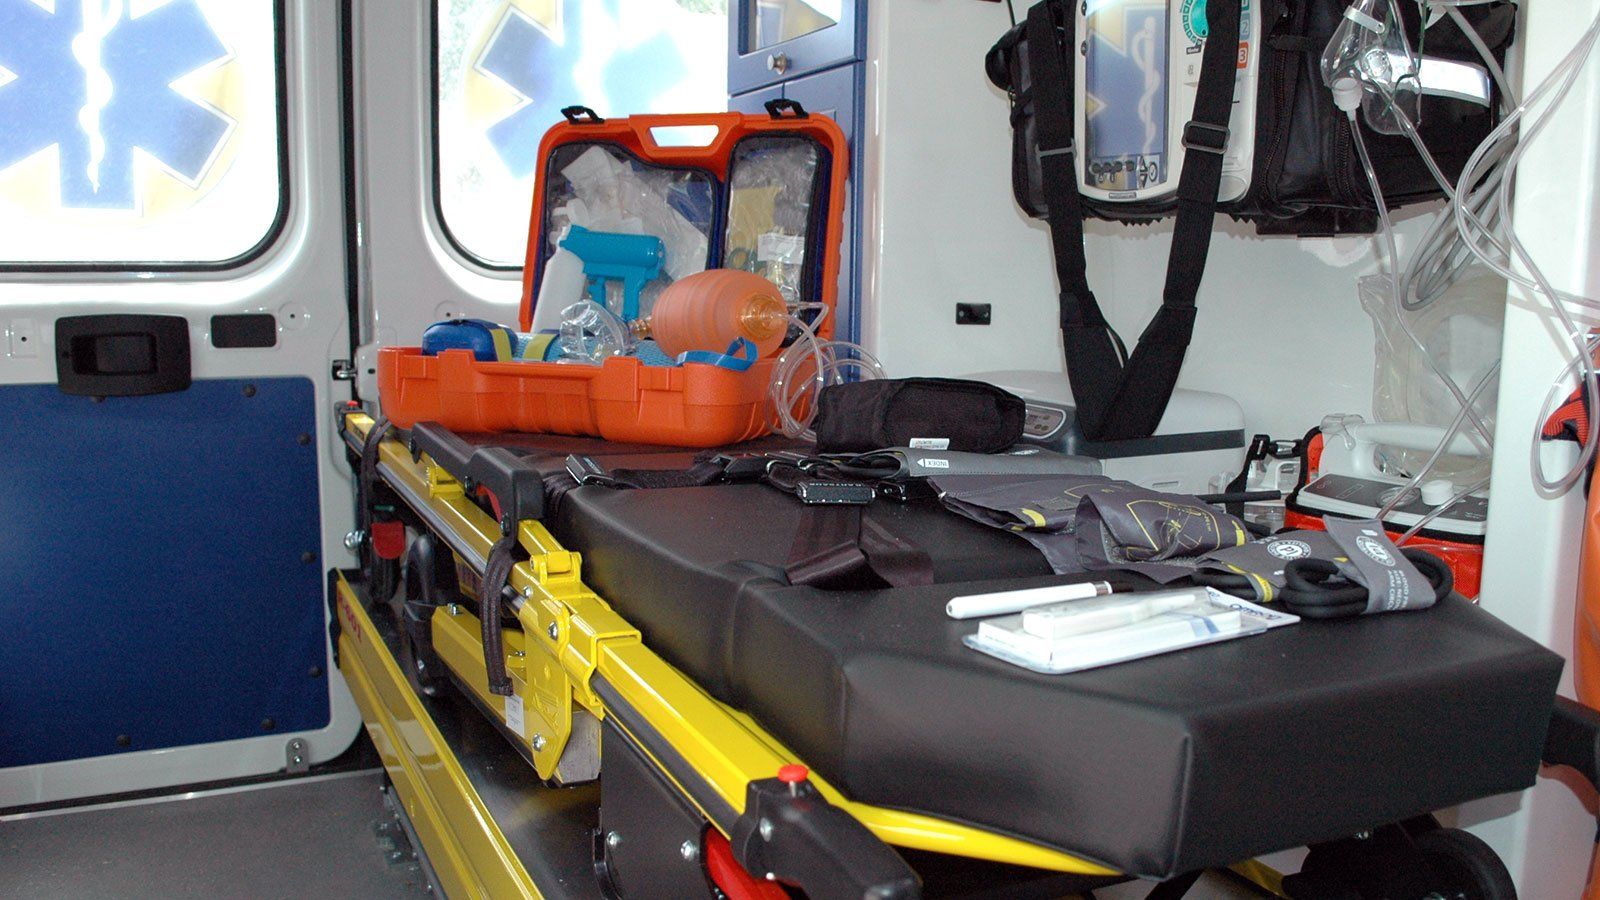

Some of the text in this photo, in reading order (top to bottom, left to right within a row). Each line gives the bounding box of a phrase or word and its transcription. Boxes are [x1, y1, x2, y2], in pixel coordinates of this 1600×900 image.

[1242, 21, 1248, 33] 2
[1239, 49, 1246, 62] 3
[1398, 569, 1409, 594] BLOOD
